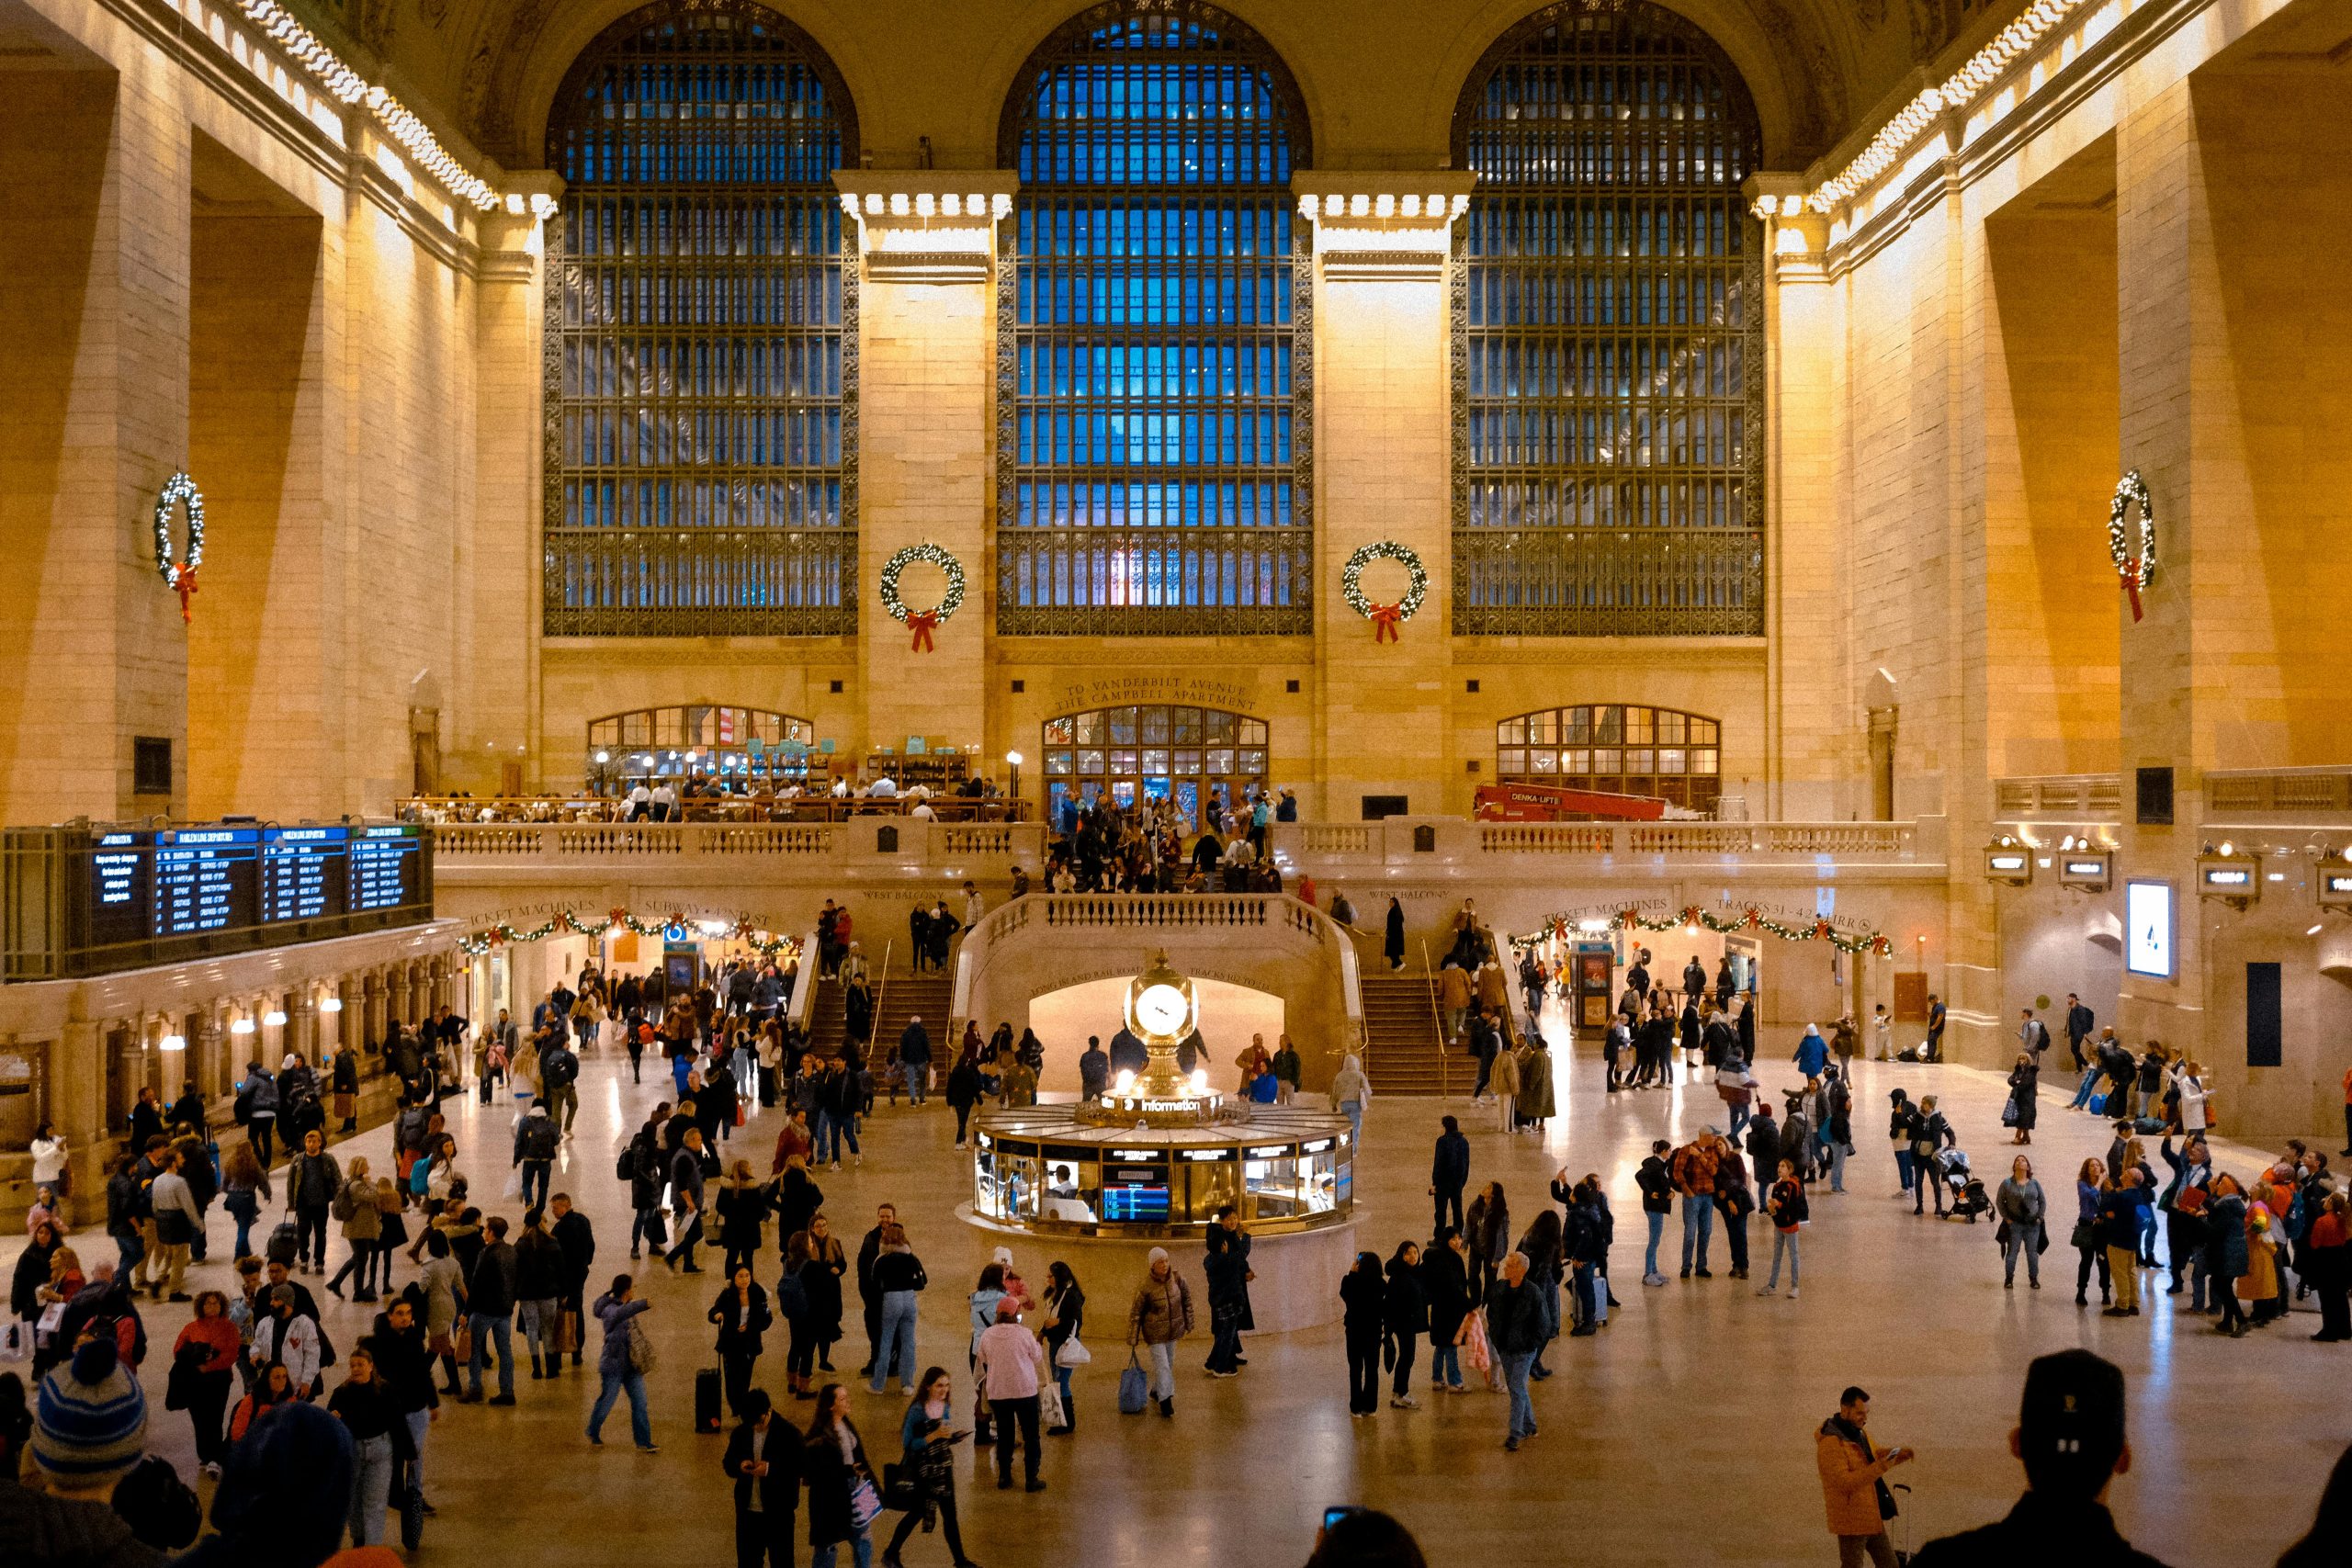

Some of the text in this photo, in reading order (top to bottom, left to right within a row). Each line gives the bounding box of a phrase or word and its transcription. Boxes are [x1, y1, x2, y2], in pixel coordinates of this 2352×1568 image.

[1066, 677, 1247, 696] TO VANDERBILT AVENUE
[1055, 689, 1257, 712] THE CAMPBELL APARTMENT
[1511, 793, 1537, 802] DENKA
[863, 890, 944, 900] WEST BALCONY
[1368, 890, 1450, 900] WEST BALCONY
[469, 899, 596, 927] ICKET MACHINES
[645, 900, 700, 916] SUBWAY
[1542, 898, 1668, 923] TICKET MACHINES
[1714, 898, 1770, 913] TRACKS
[1190, 967, 1225, 979] TRACKS
[1141, 1099, 1200, 1112] Information
